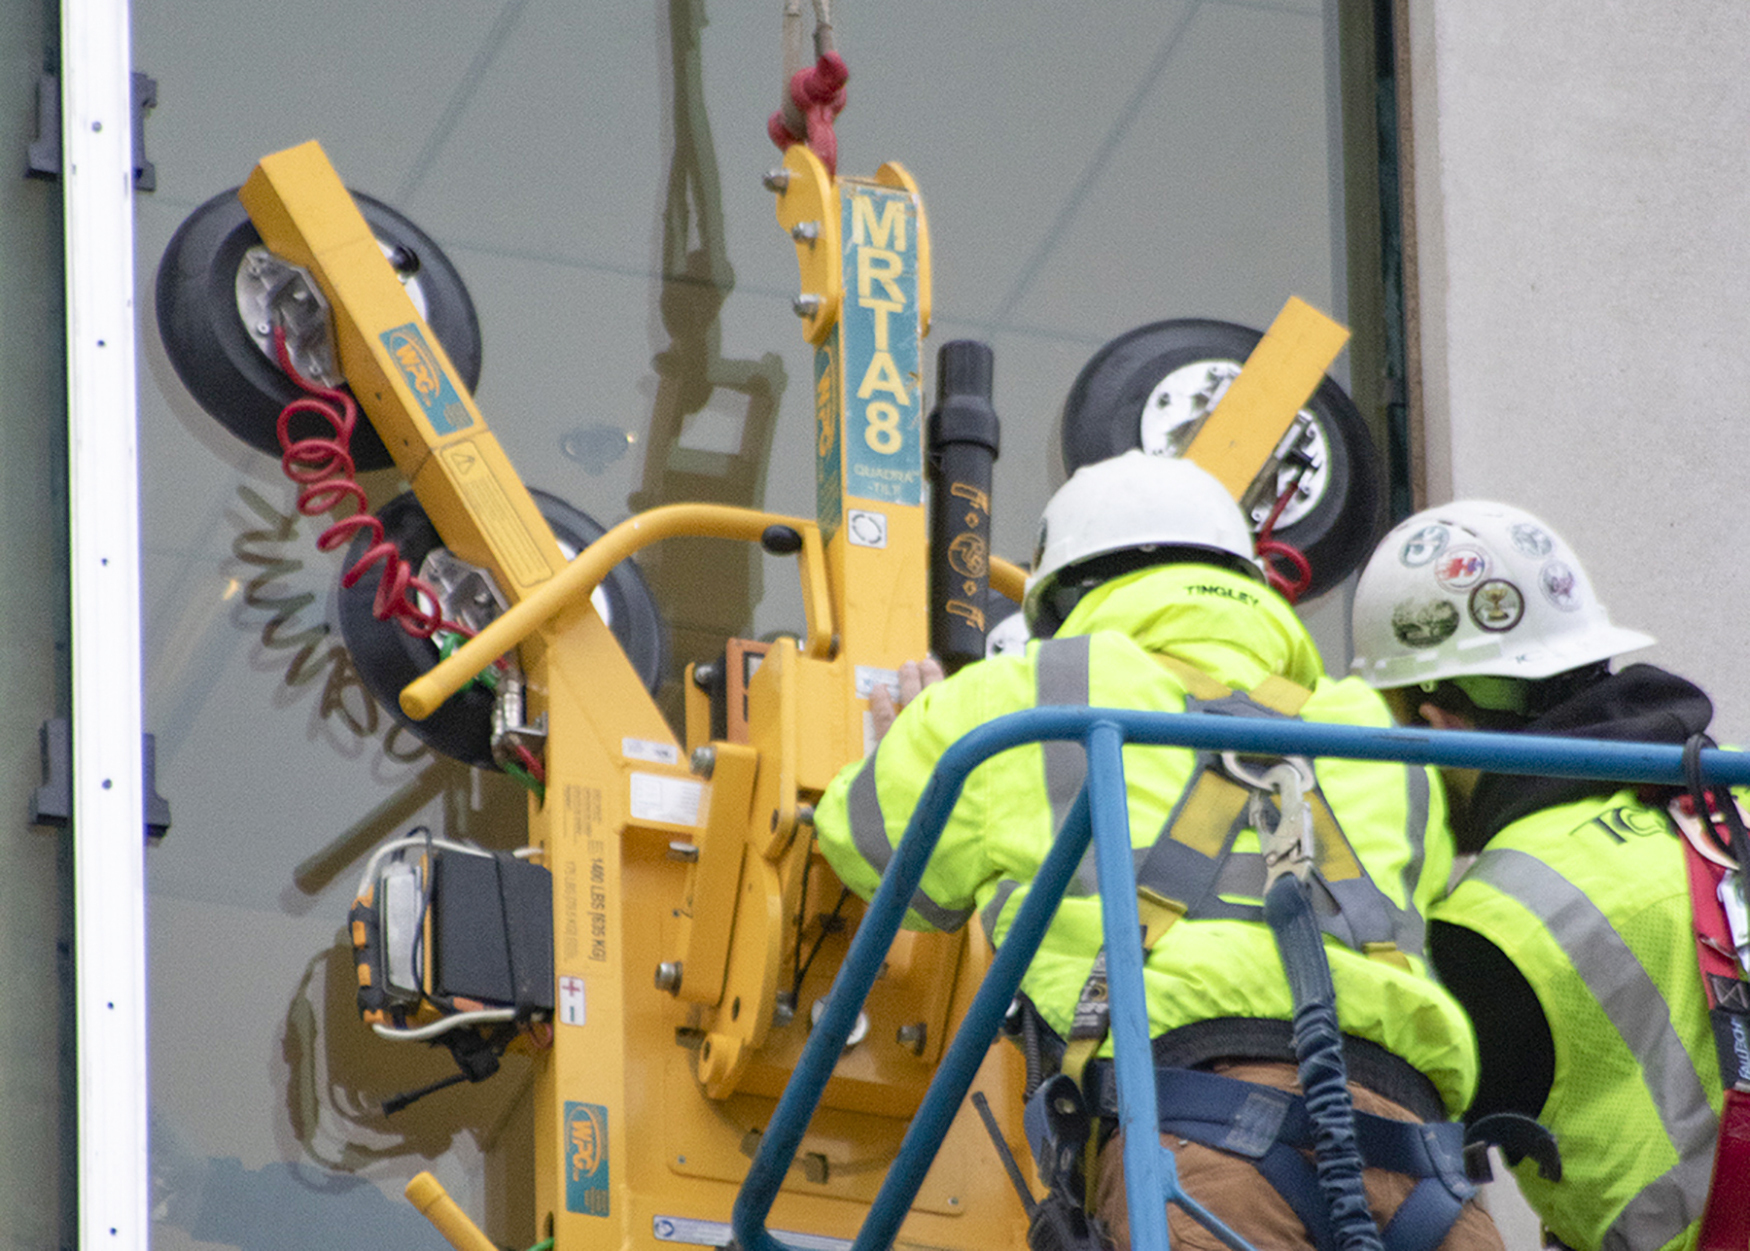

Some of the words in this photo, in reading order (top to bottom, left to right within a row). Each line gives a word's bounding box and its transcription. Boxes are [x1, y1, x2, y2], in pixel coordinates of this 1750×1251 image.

[850, 194, 911, 455] MRTA8
[396, 342, 435, 394] WPG
[1184, 585, 1259, 607] TINGLEY
[590, 858, 605, 883] 1400
[590, 885, 606, 910] LBS
[570, 1120, 593, 1170] WPG
